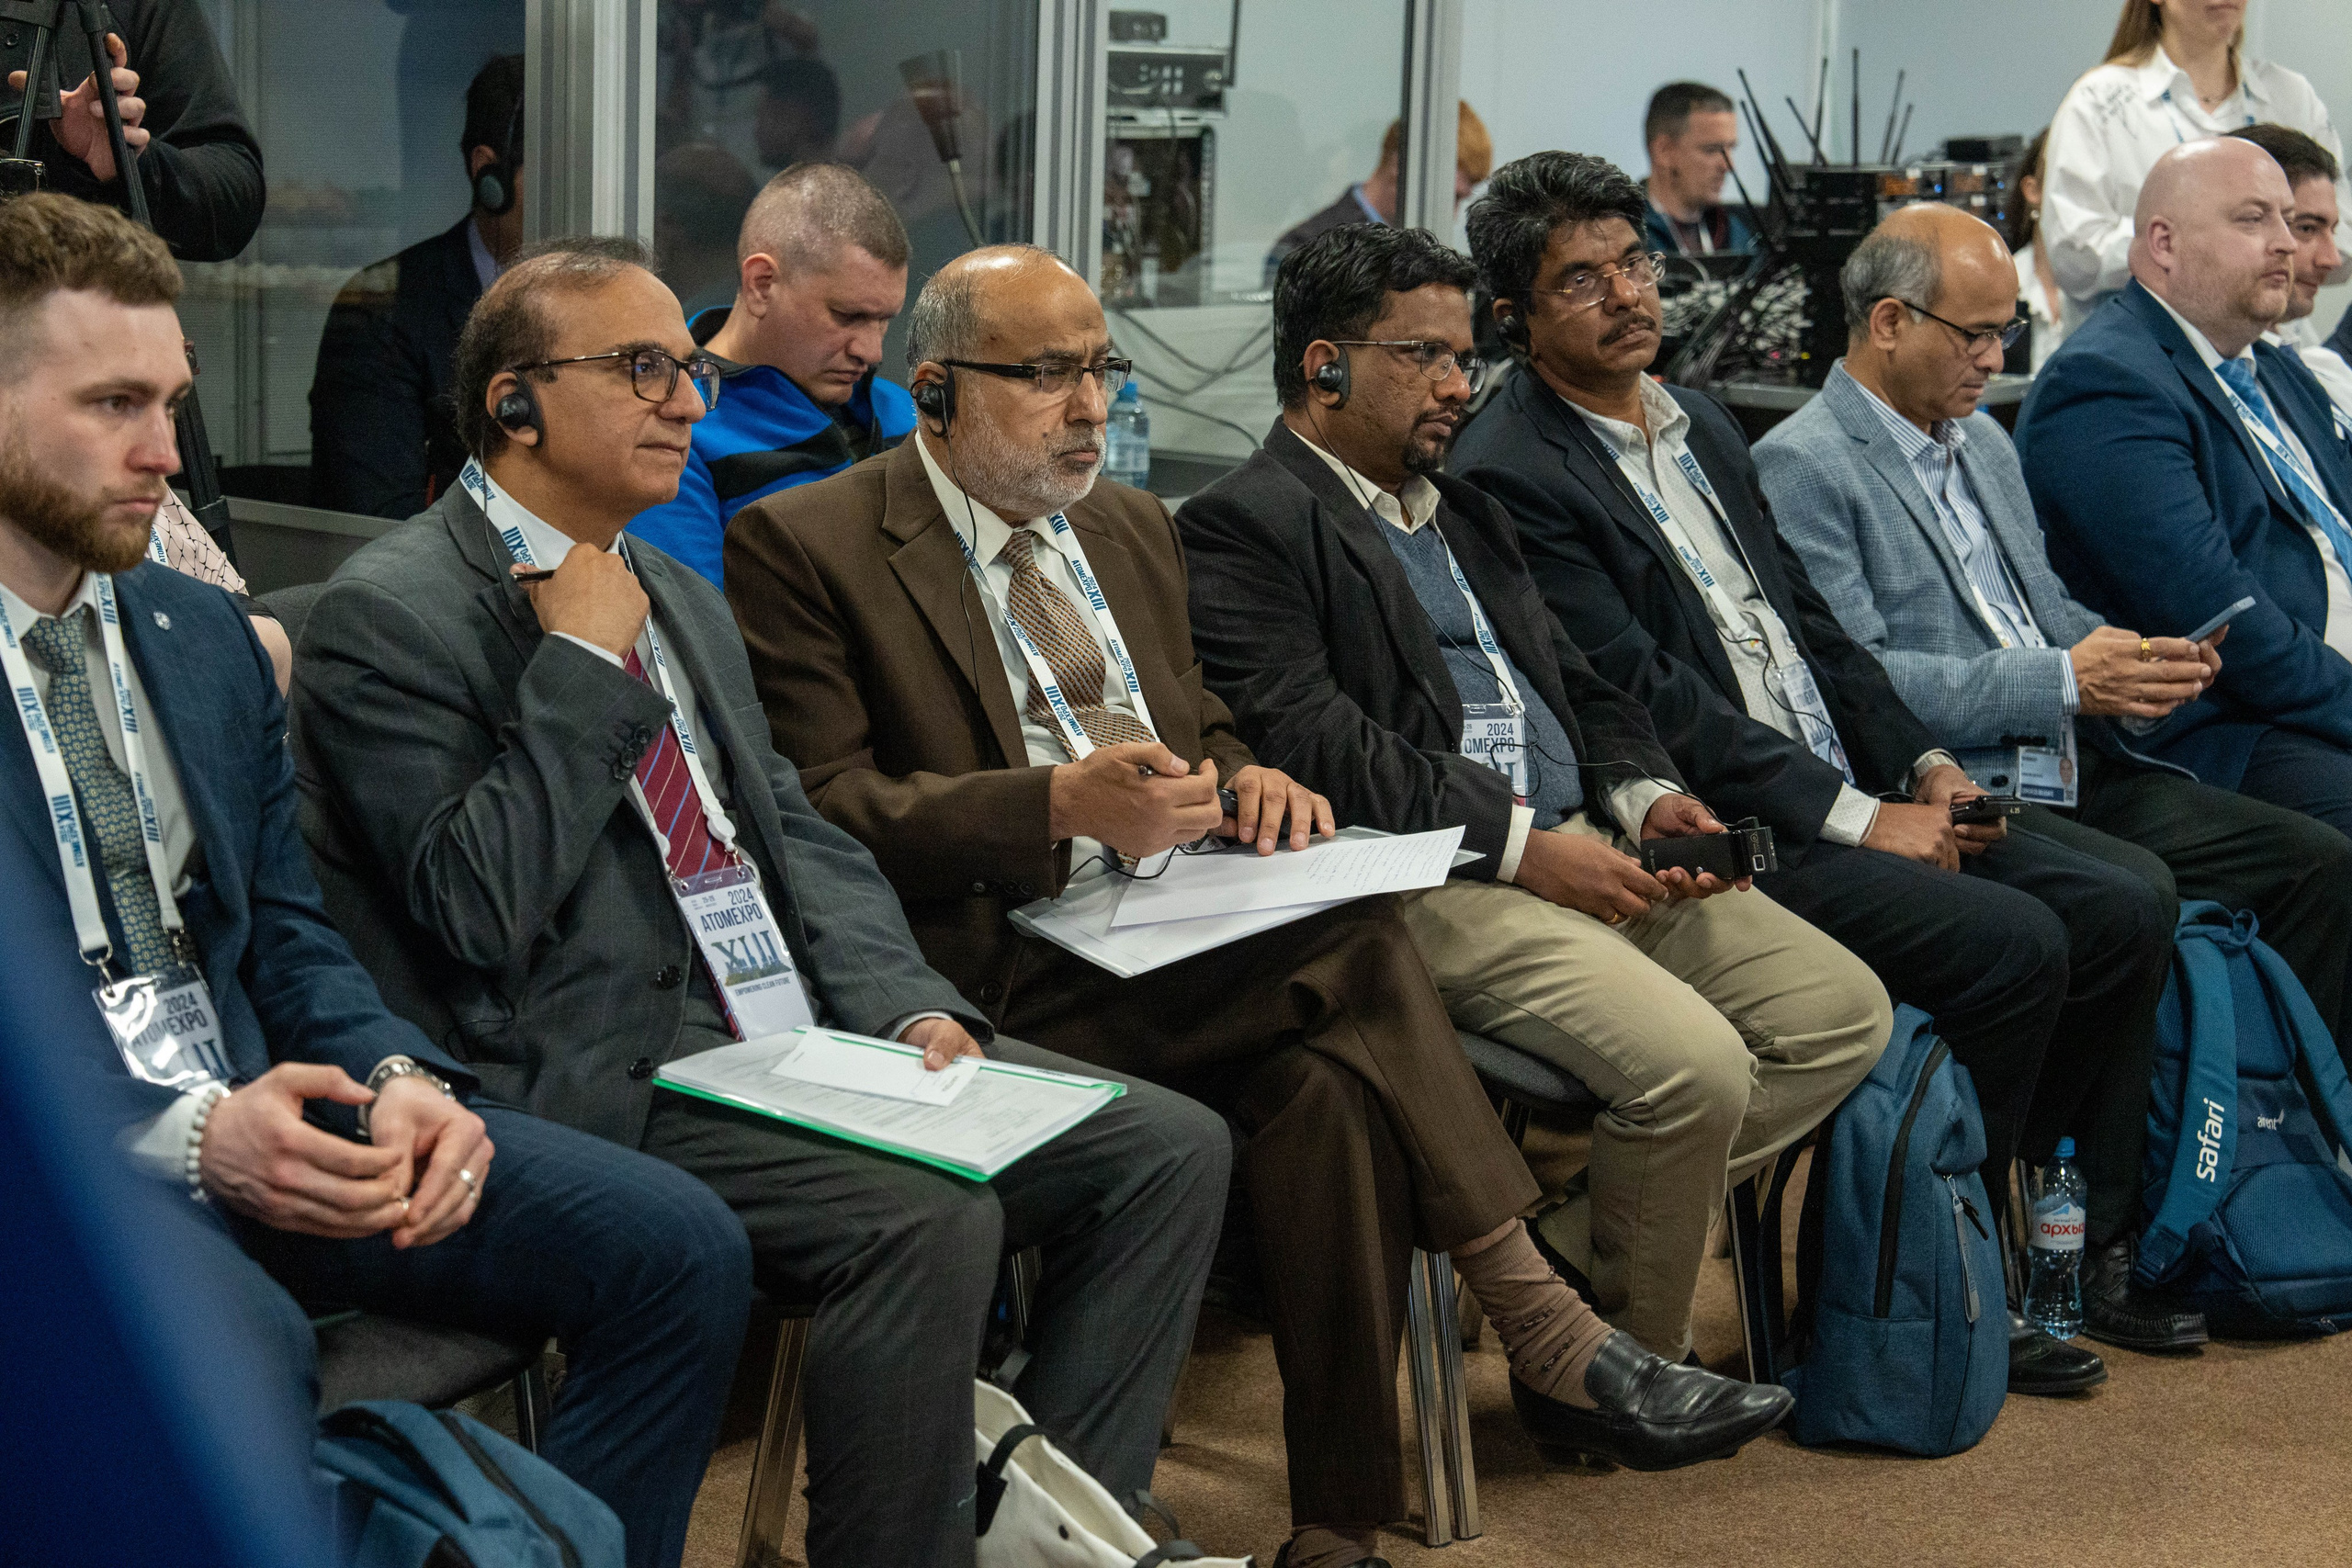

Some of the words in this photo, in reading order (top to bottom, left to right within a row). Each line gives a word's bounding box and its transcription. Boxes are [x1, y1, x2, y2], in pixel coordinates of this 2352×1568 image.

[1679, 452, 1697, 473] XIII
[1049, 513, 1069, 535] XIII
[1650, 502, 1669, 524] XIII
[502, 526, 526, 554] XIII
[1071, 559, 1092, 592] ATOMEXPO
[1088, 576, 1097, 590] 2024
[1697, 568, 1715, 587] XIII
[1087, 589, 1107, 611] XIII
[1110, 638, 1127, 672] ATOMEXPO
[1480, 638, 1498, 654] XIII
[1125, 671, 1139, 693] XIII
[1045, 685, 1065, 707] XIII
[1060, 705, 1084, 736] ATOMEXPO
[1487, 722, 1513, 736] 2024
[679, 730, 695, 754] XIII
[1464, 737, 1515, 754] OMEXPO
[728, 887, 754, 905] 2024
[700, 903, 763, 932] ATOMEXPO
[2196, 1098, 2224, 1182] safari
